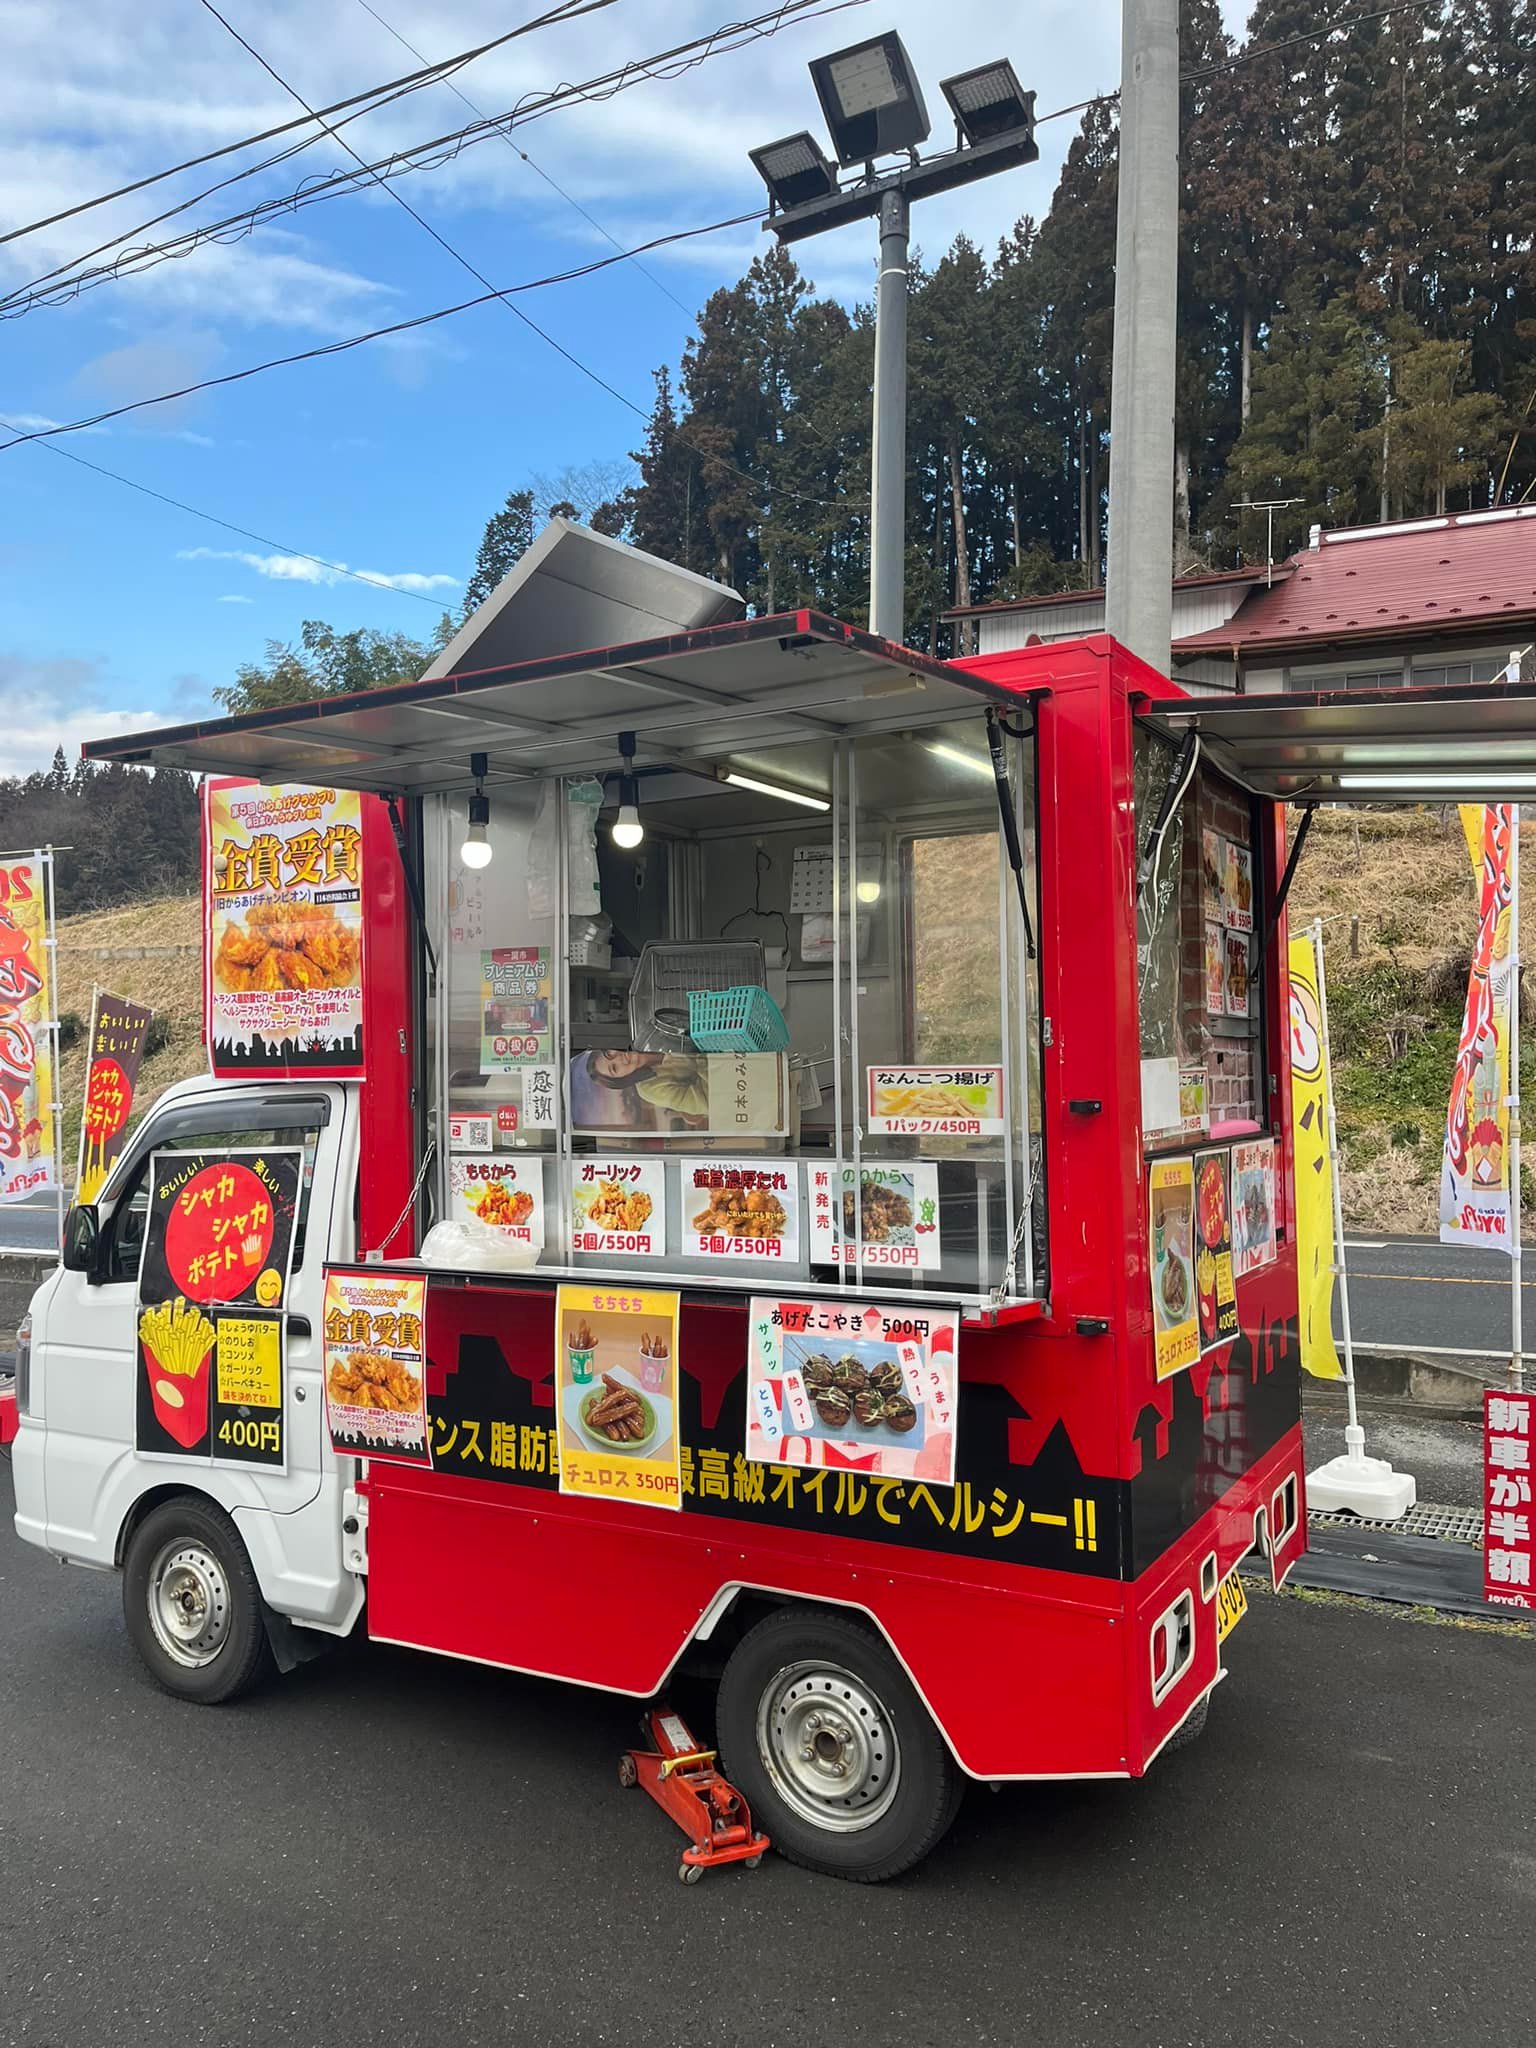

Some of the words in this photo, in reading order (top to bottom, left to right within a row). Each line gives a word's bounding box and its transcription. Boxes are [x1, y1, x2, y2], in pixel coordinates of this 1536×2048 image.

[213, 824, 361, 894] 金賞受賞
[485, 961, 546, 979] プレミアム付
[494, 980, 538, 996] 商品券
[100, 1012, 145, 1029] おいしい
[96, 1034, 138, 1053] 楽しい!
[494, 1038, 538, 1053] 取扱店
[91, 1065, 119, 1086] シャカ
[876, 1071, 995, 1086] なんこつ揚げ
[93, 1084, 123, 1107] シャカ
[532, 1070, 553, 1121] 感謝
[85, 1102, 120, 1132] ポテト!
[885, 1118, 981, 1134] 1パック/450円
[158, 1157, 207, 1200] おいしい!
[252, 1157, 281, 1195] 楽しい
[466, 1163, 518, 1181] ももから
[582, 1164, 642, 1182] ガーリック
[692, 1169, 788, 1190] 極旨濃厚たれ
[842, 1167, 902, 1184] のりから
[180, 1175, 236, 1216] シャカ
[814, 1171, 829, 1229] 新発売
[211, 1201, 269, 1242] シャカ
[573, 1232, 651, 1253] 5個/550円
[699, 1236, 781, 1256] 5個/550円
[187, 1245, 238, 1285] ポテト
[592, 1295, 643, 1313] もちもち
[225, 1323, 277, 1334] しょうゆバター
[325, 1307, 422, 1350] 金賞受賞
[771, 1309, 864, 1332] あげたこやき
[881, 1318, 929, 1338] 500円
[225, 1336, 254, 1347] のりしお
[758, 1323, 777, 1370] サクッ
[226, 1350, 255, 1361] コンソメ
[226, 1364, 263, 1375] ガーリック
[902, 1347, 922, 1397] 熱っ!
[226, 1378, 270, 1389] バーベキュー
[787, 1376, 806, 1424] 熱っ!
[759, 1389, 777, 1435] とろっ
[218, 1419, 280, 1452] 400円
[565, 1463, 630, 1488] チュロス
[635, 1473, 679, 1494] 350円
[1487, 1398, 1531, 1586] 新車が半額
